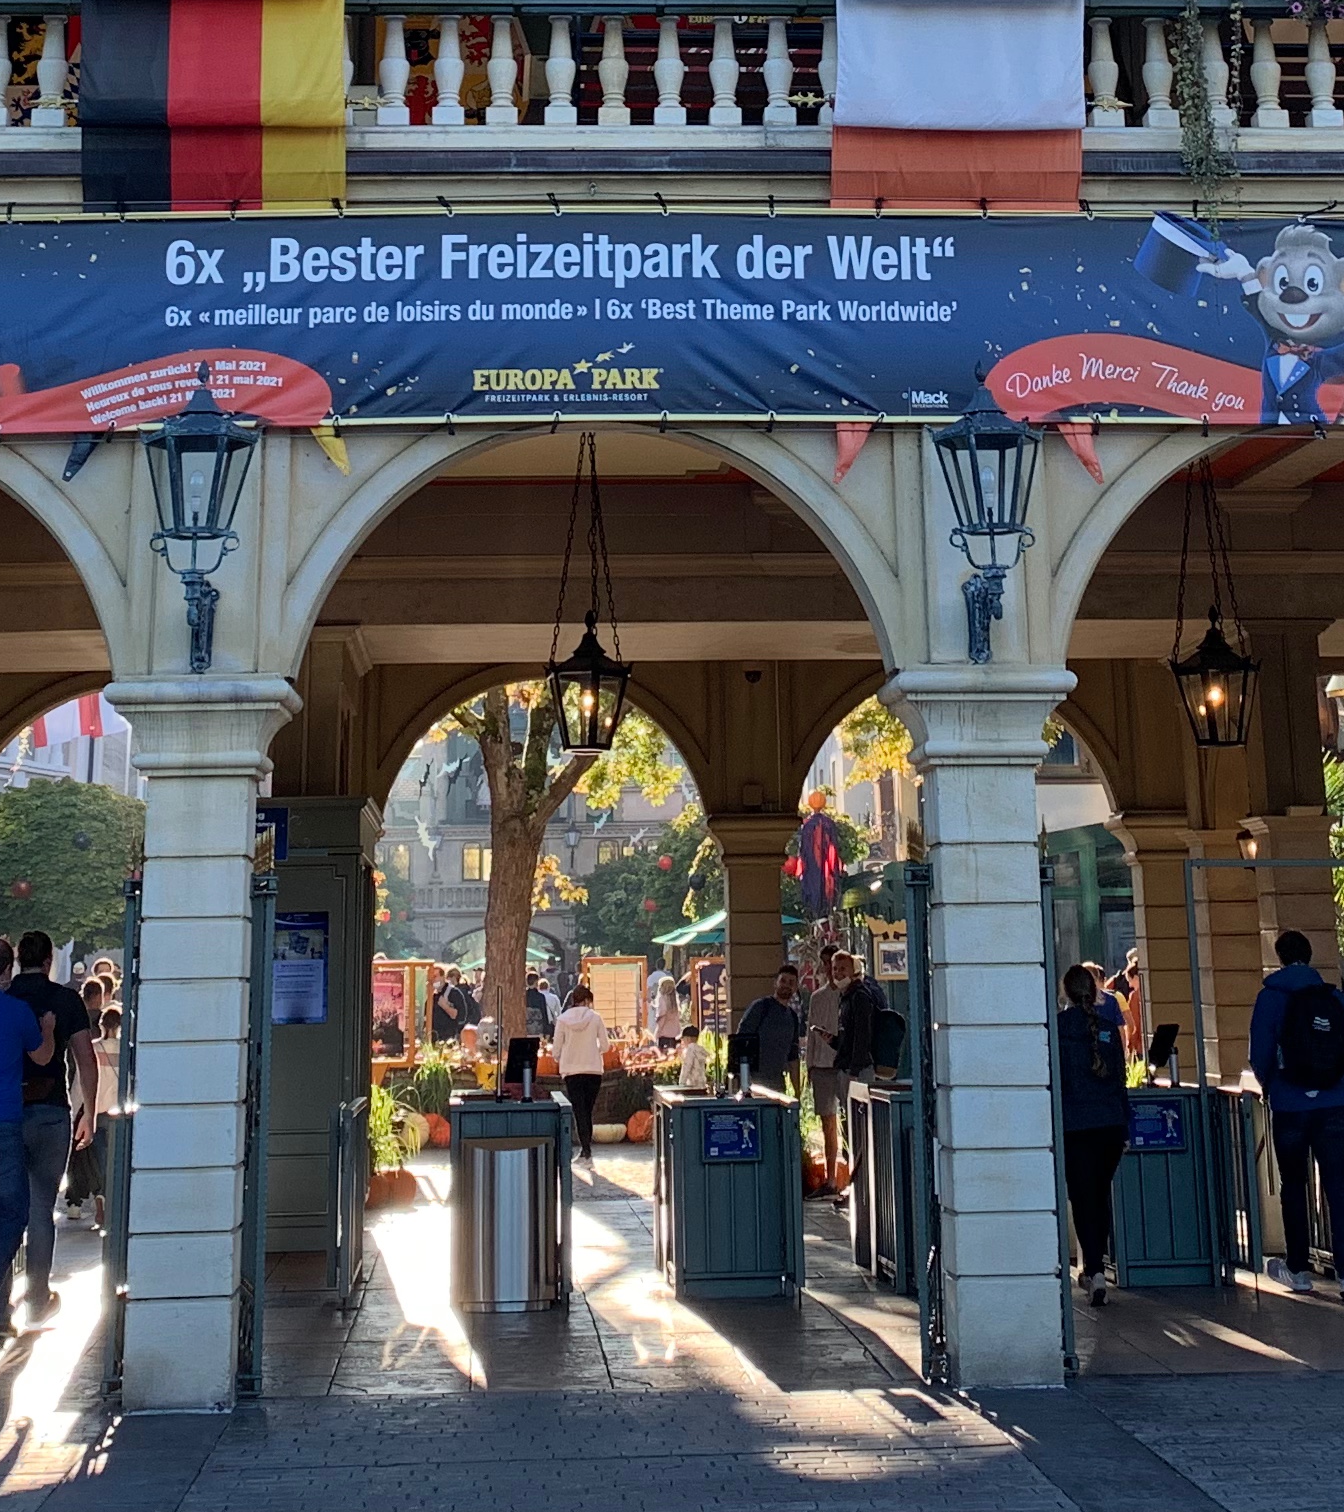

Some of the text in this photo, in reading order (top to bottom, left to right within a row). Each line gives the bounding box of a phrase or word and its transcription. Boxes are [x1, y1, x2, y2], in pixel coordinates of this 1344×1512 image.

[165, 239, 224, 286] 6x
[440, 232, 721, 289] Freizeitpark
[736, 234, 813, 281] der
[165, 306, 192, 327] 6x
[309, 306, 356, 328] parc
[363, 302, 389, 323] de
[396, 300, 461, 323] loisirs
[467, 299, 494, 321] du
[606, 299, 633, 319] 6x
[702, 299, 775, 321] Theme
[781, 300, 832, 322] Park
[80, 372, 148, 400] Willkommen
[150, 362, 192, 381] zurück!
[215, 361, 236, 371] Mai
[239, 360, 266, 372] 2021
[85, 391, 130, 414] Heureux
[131, 386, 145, 398] de
[146, 381, 173, 394] vous
[216, 374, 230, 386] 21
[232, 375, 255, 386] mai
[256, 375, 283, 388] 2021
[472, 367, 660, 392] EUROPA PARK
[1006, 353, 1245, 412] Danke Merci Thank you
[90, 401, 138, 426] Welcome
[139, 394, 168, 411] back!
[170, 391, 183, 405] 21
[484, 393, 551, 404] FREIZEITPARK
[563, 392, 649, 403] ERLEBNIS-RESORT
[910, 390, 949, 405] Mack
